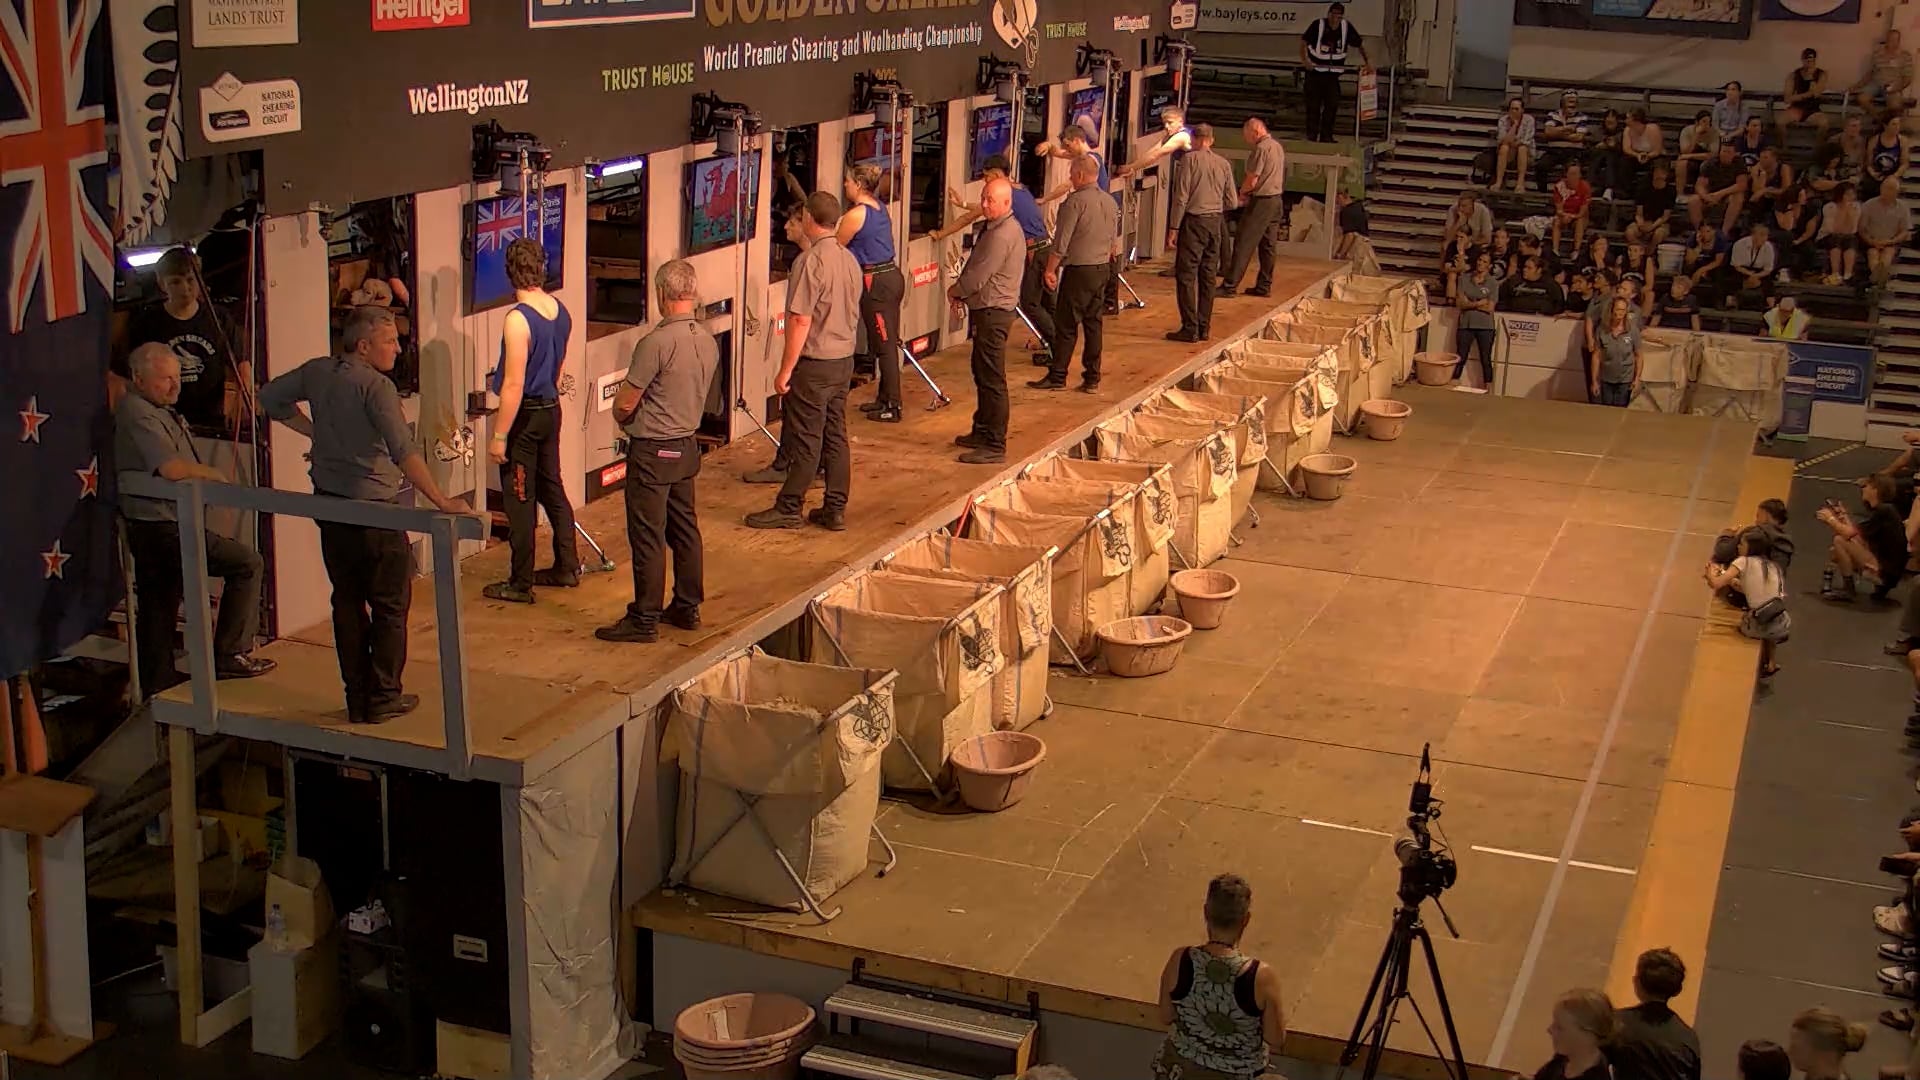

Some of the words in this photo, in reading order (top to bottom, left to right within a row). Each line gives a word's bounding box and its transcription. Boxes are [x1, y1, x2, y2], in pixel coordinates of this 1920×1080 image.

[208, 10, 247, 26] LANDS
[250, 9, 286, 25] TRUST
[704, 44, 739, 72] World
[744, 41, 788, 68] Premier
[791, 35, 839, 62] Shearing
[842, 31, 860, 56] and
[862, 27, 924, 52] Woolhandling
[925, 21, 982, 49] Championship
[602, 66, 648, 92] TRUST
[652, 62, 695, 87] HOUSE
[261, 89, 294, 101] NATIONAL
[408, 79, 529, 115] WellingtonNZ
[262, 100, 295, 113] SHEARING
[262, 113, 288, 125] CIRCUIT
[1817, 366, 1856, 376] NATIONAL
[1815, 381, 1846, 390] CIRCUIT
